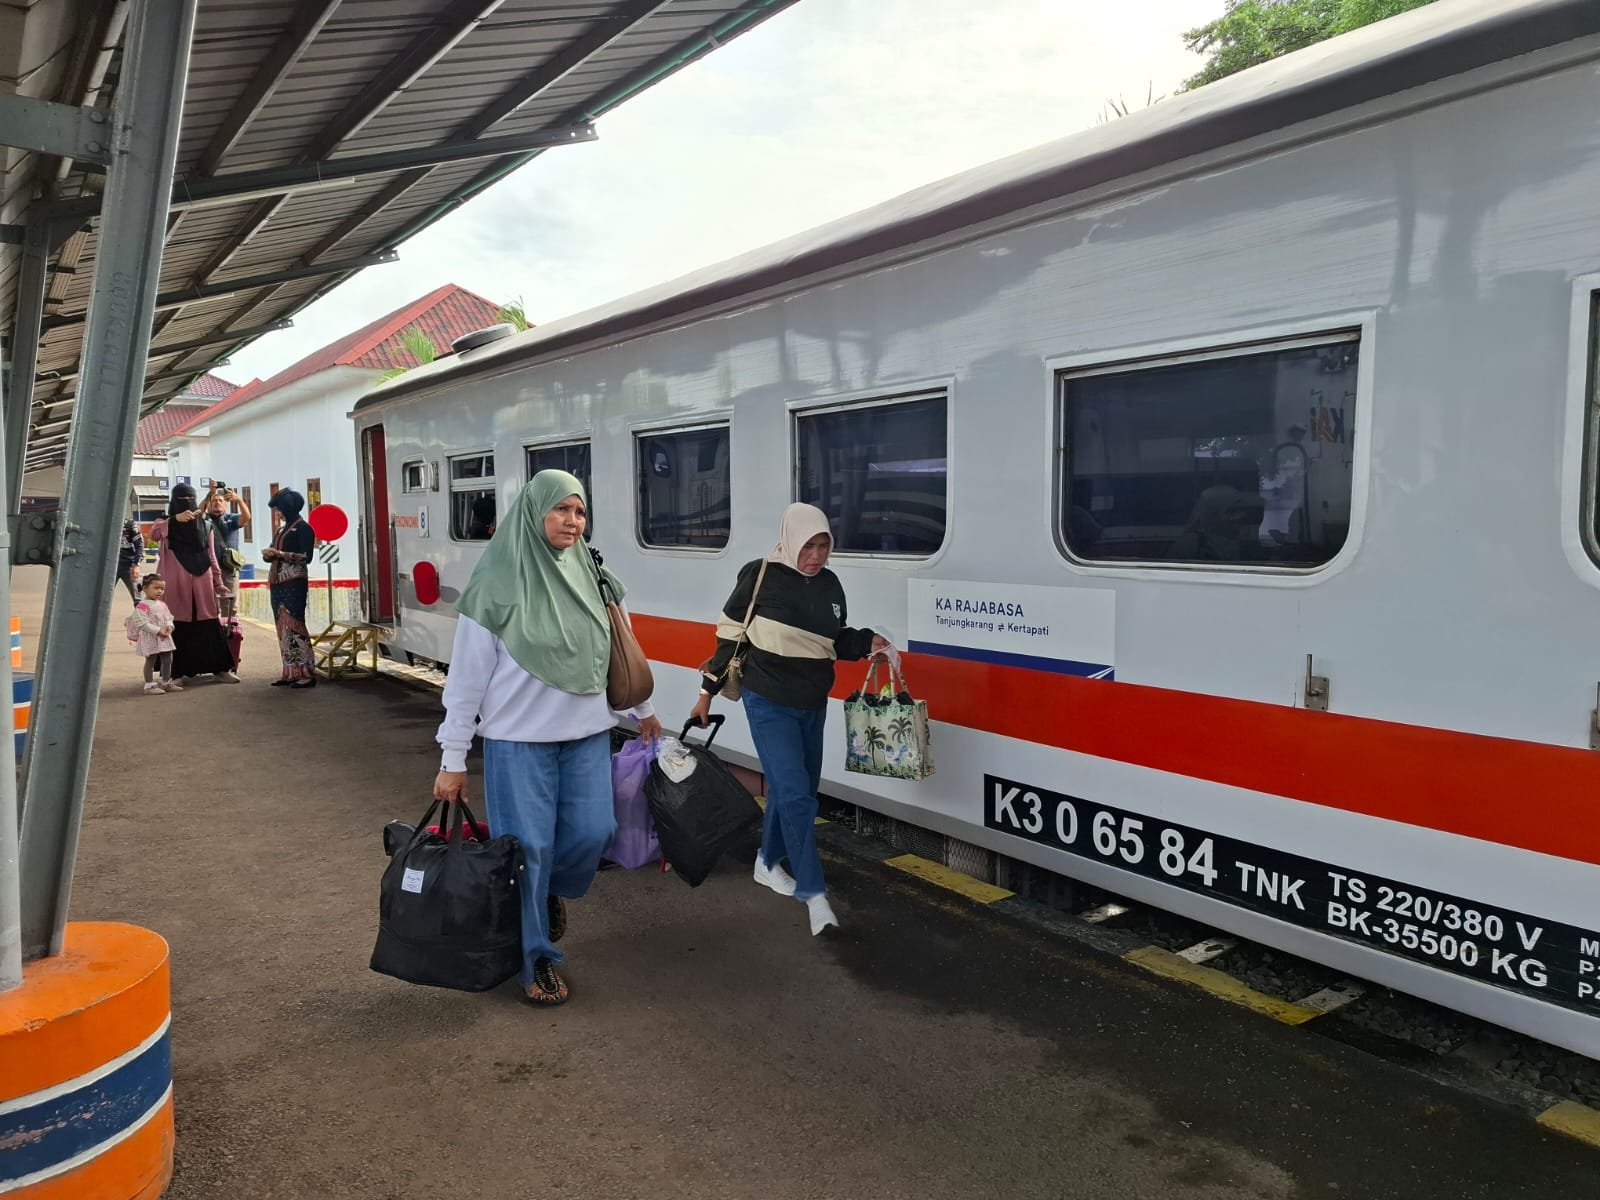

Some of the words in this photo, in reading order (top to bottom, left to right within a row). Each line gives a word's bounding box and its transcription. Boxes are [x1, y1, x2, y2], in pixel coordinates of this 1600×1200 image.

[420, 511, 426, 529] 8
[936, 598, 952, 611] KA
[955, 599, 1025, 618] RAJABASA
[936, 615, 994, 632] Tanjungkarang
[1007, 623, 1049, 637] Kertapati
[995, 783, 1043, 834] K3
[1056, 801, 1078, 844] 0
[1093, 811, 1145, 864] 65
[1159, 828, 1218, 887] 84
[1235, 860, 1306, 911] TNK
[1328, 871, 1367, 903] TS
[1376, 886, 1504, 941] 220/380
[1515, 922, 1543, 951] V
[1327, 901, 1479, 967] BK-35500
[1491, 948, 1548, 987] KG
